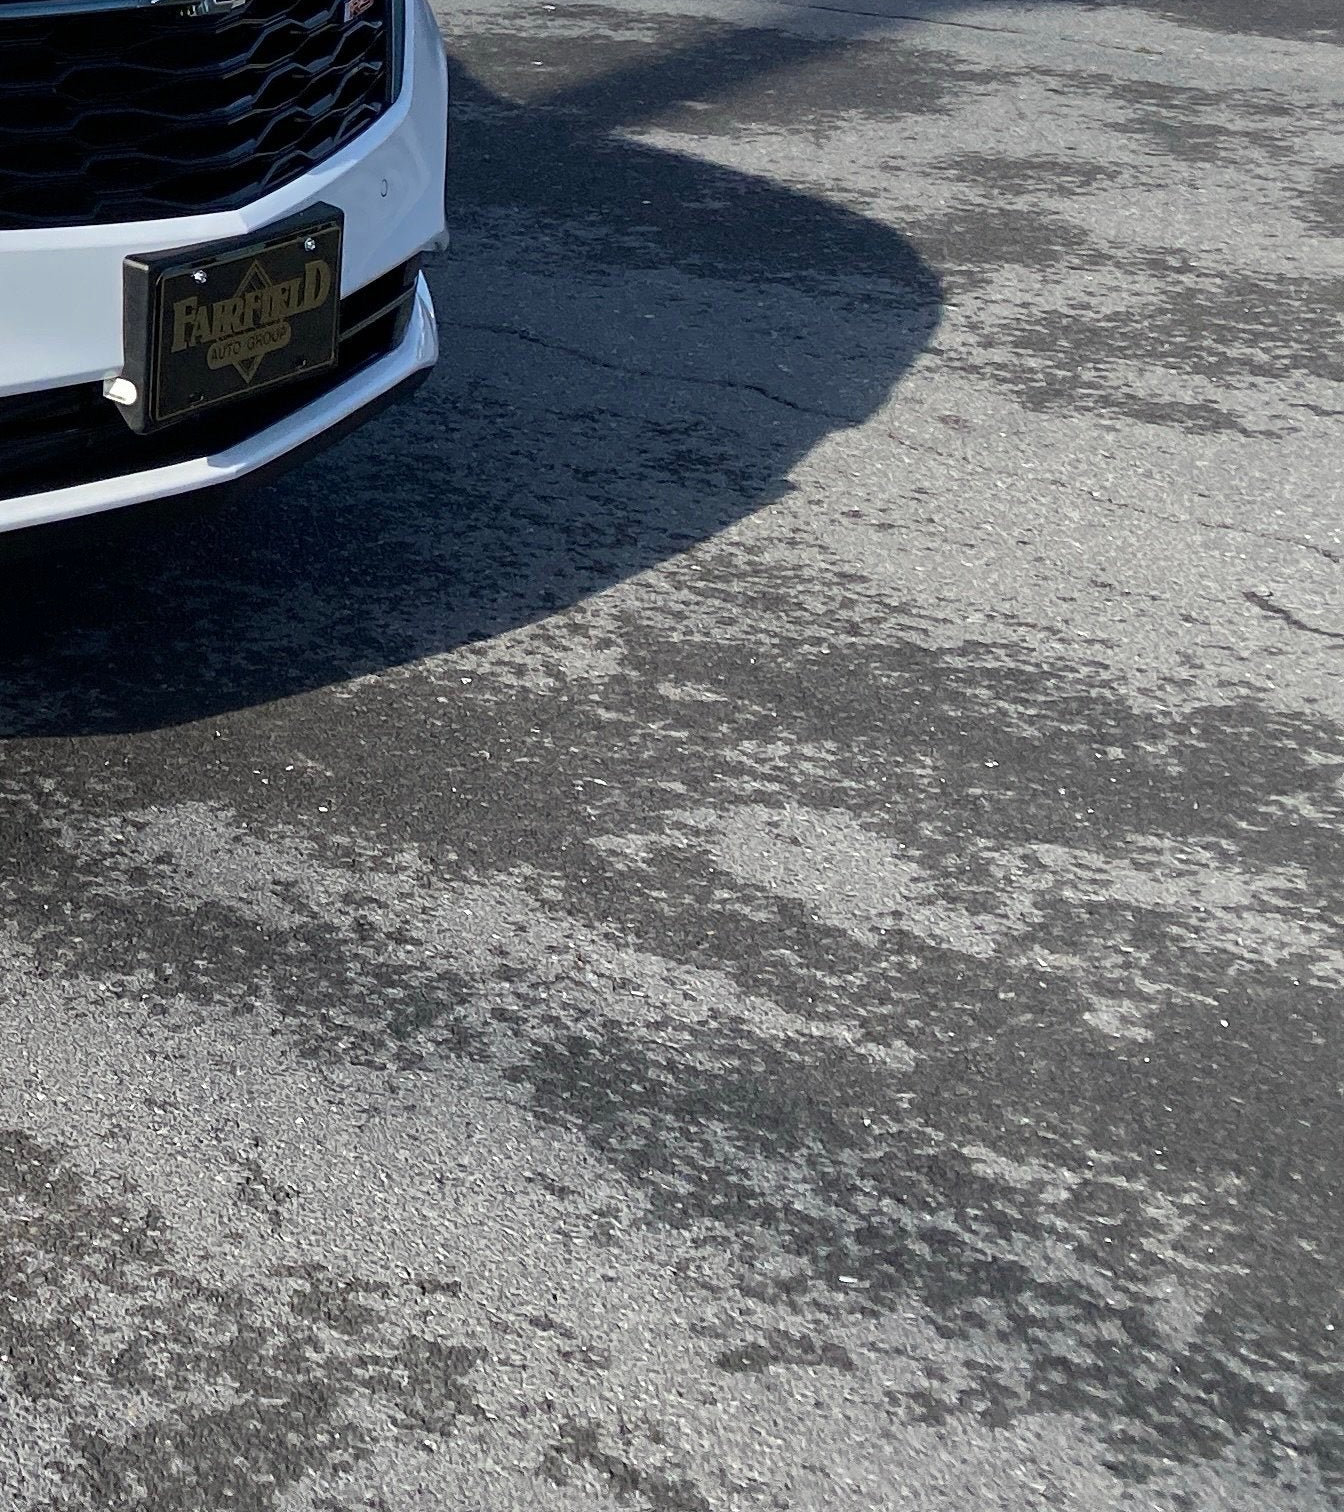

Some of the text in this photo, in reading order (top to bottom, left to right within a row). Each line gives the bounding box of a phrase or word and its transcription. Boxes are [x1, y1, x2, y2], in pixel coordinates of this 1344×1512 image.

[171, 259, 332, 353] FAIRFIELD
[211, 325, 288, 361] AUTO GROUP
